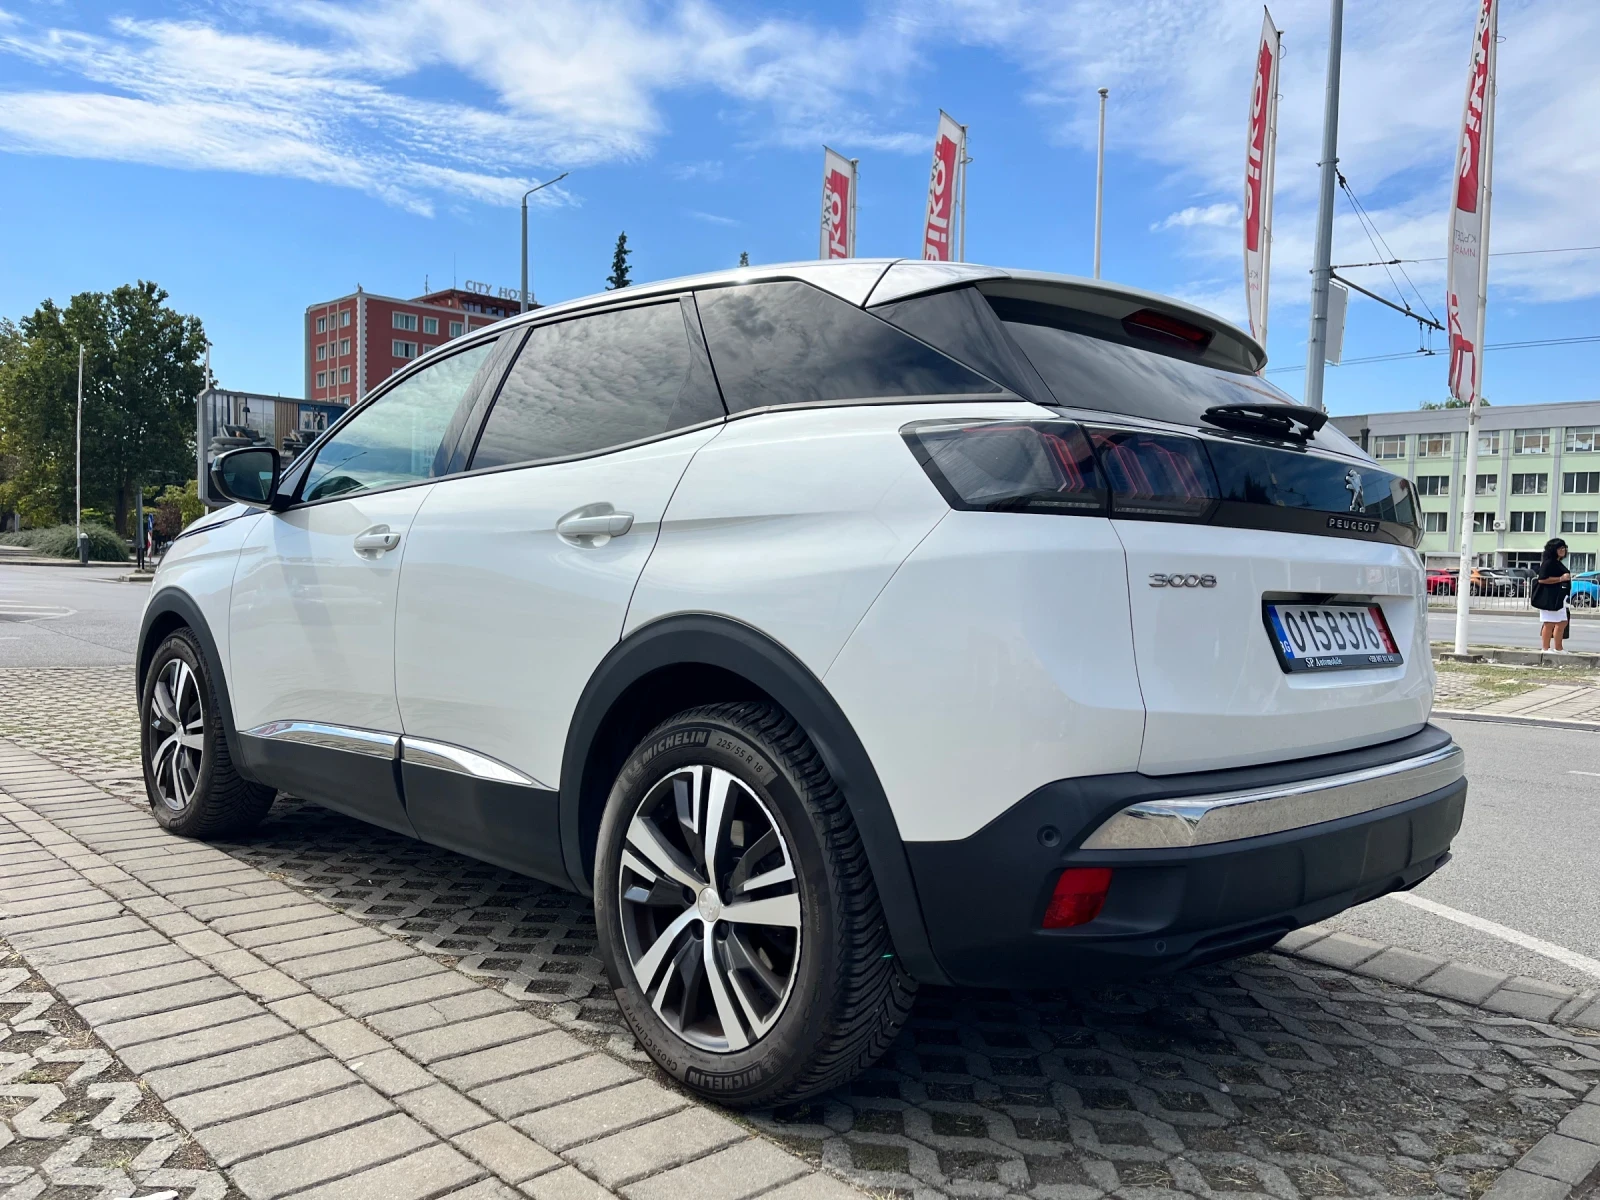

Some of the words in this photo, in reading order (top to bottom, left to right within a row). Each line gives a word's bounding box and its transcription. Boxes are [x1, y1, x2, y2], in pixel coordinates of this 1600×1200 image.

[465, 280, 492, 295] CITY
[1329, 518, 1376, 532] PEUGEOT
[1149, 573, 1217, 588] 3008
[1284, 611, 1380, 652] 015B376
[642, 731, 707, 764] MICHELIN
[716, 738, 746, 758] 225/55
[745, 755, 753, 764] R
[753, 762, 764, 773] 18
[624, 1004, 678, 1072] CROSSCLIMATE
[689, 1064, 761, 1090] MICHELIN
